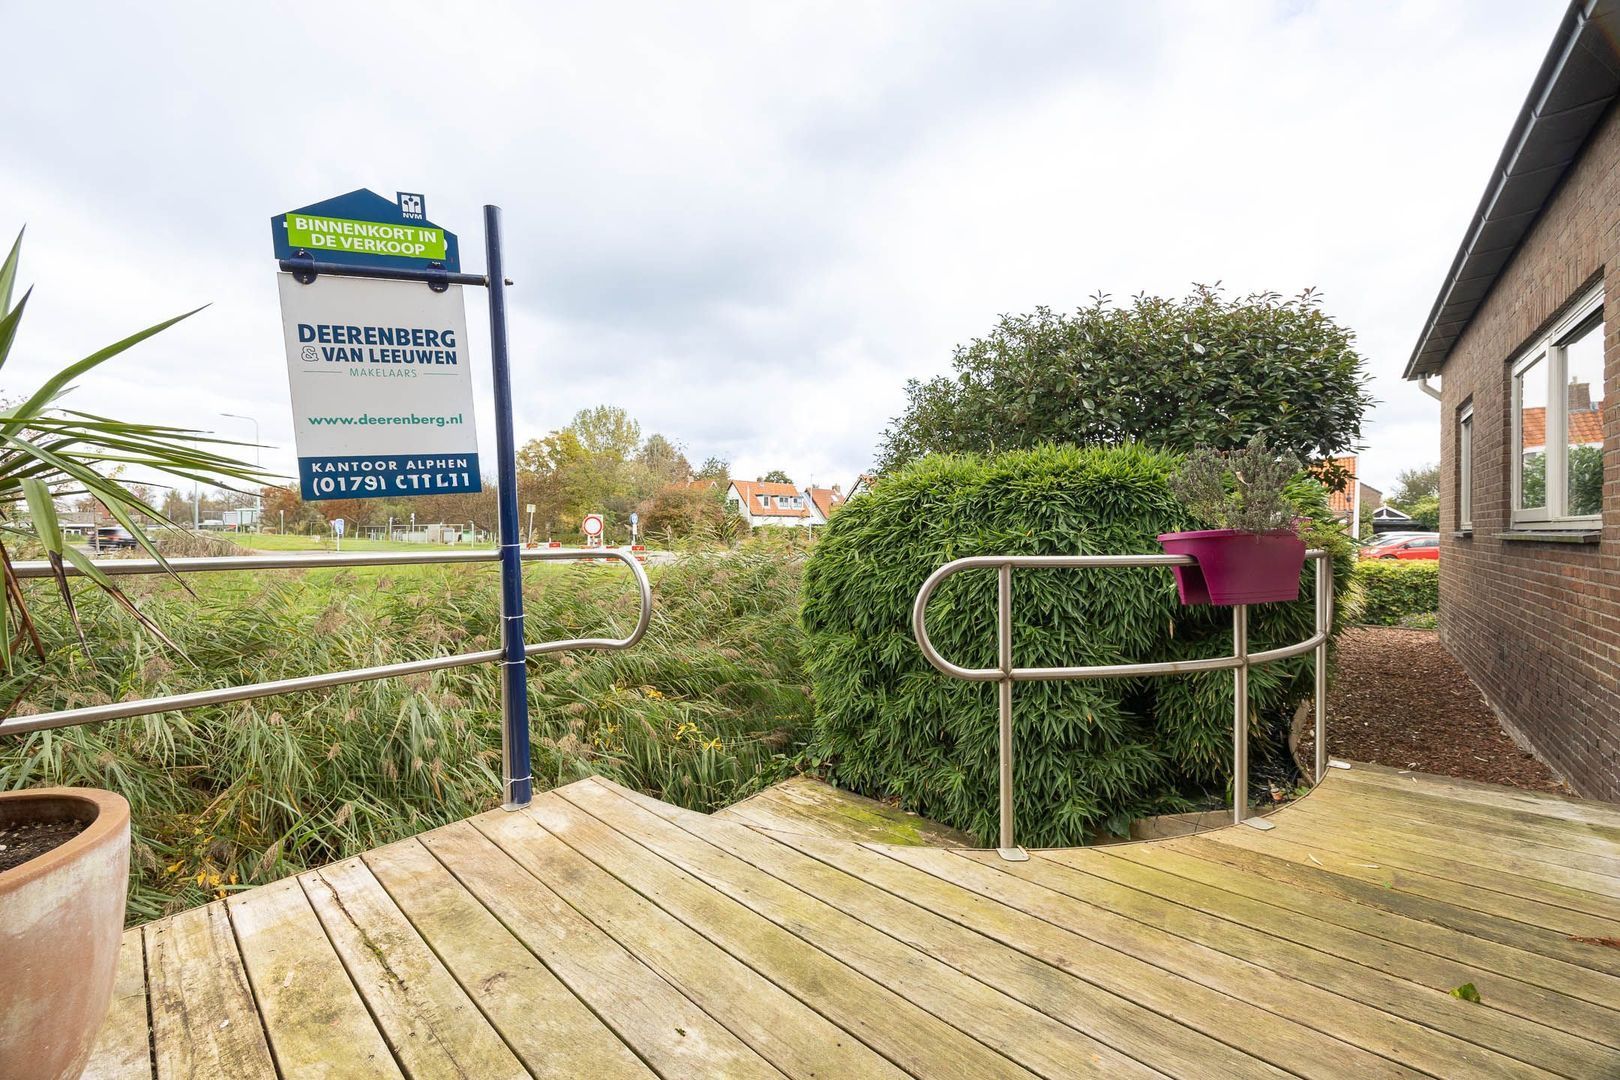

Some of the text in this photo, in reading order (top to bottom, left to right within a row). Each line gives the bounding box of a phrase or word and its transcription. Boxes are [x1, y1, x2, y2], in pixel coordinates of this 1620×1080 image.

[403, 212, 422, 220] NVM
[295, 217, 437, 243] BINNENKORT IN
[311, 233, 426, 255] DE VERKOOP
[298, 324, 456, 347] DEERENBERG
[301, 346, 457, 365] & VAN LEEUWEN
[350, 368, 417, 378] MAKELAARS
[308, 413, 463, 427] www.deerenberg.nl
[312, 458, 468, 473] KANTOOR ALPHEN
